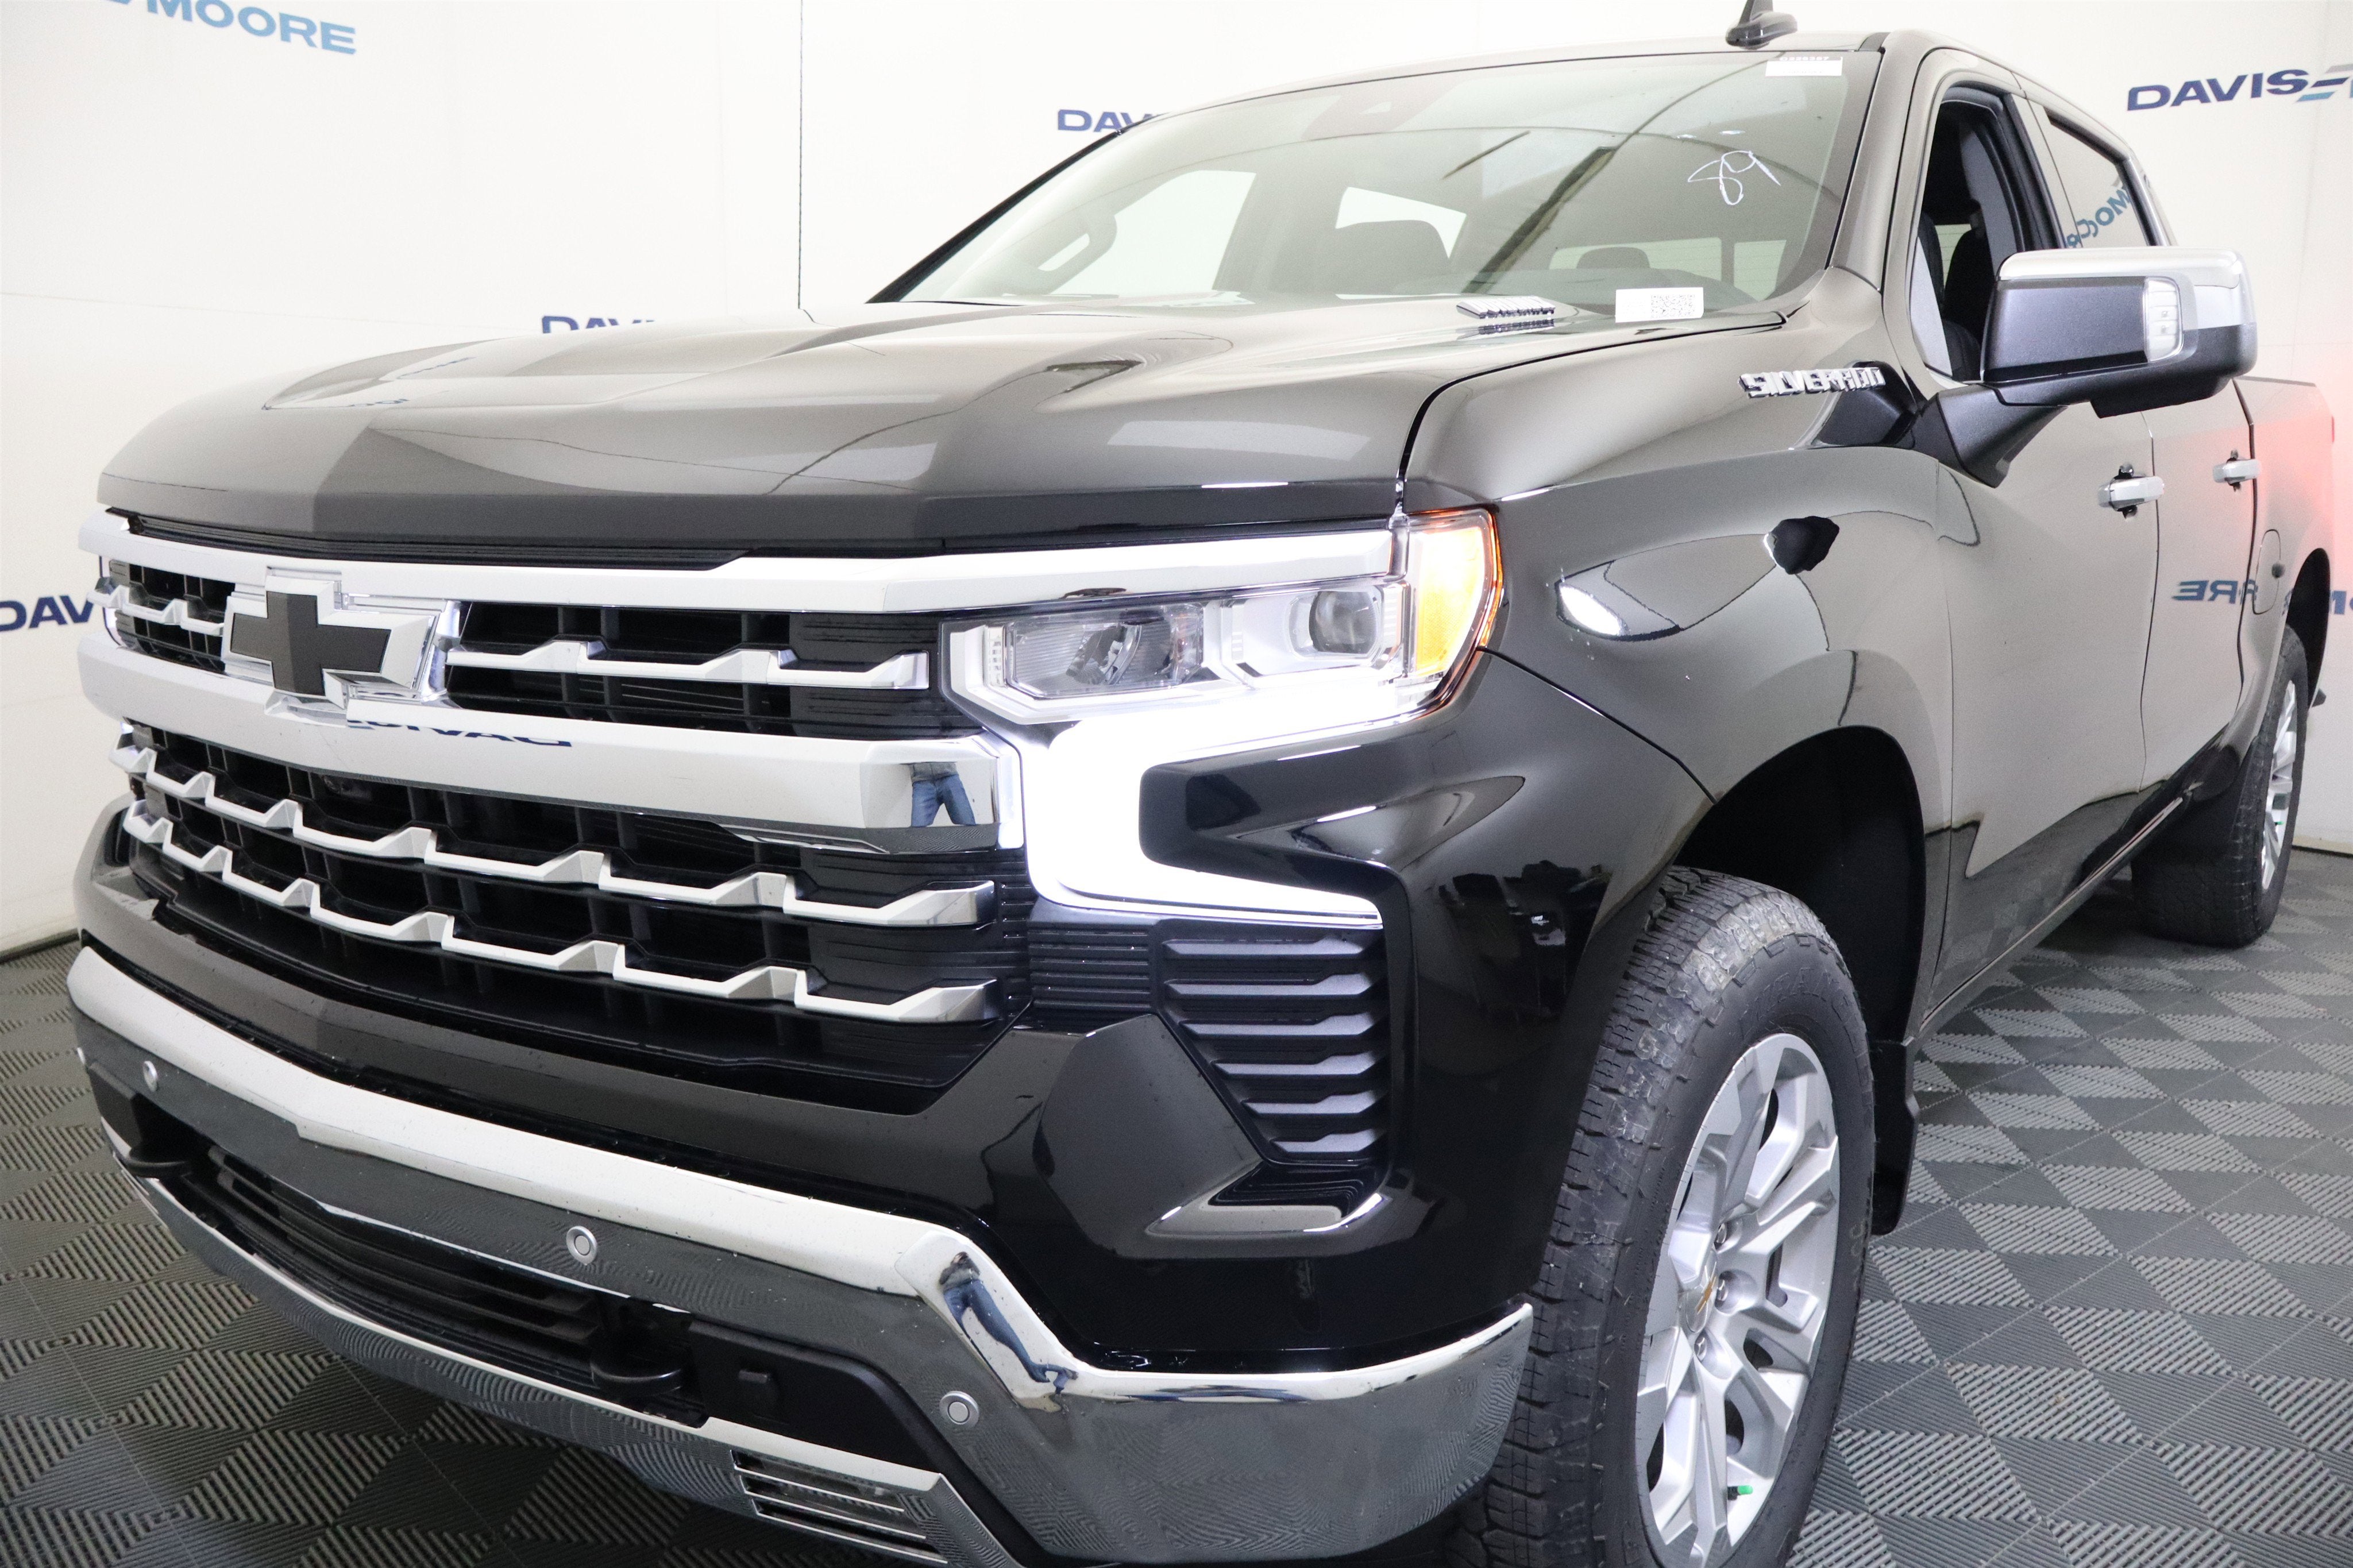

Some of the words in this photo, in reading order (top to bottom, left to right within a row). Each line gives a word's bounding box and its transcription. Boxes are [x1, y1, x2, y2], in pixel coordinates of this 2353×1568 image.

[147, 0, 356, 55] MOORE
[2127, 69, 2309, 111] DAVIS
[1738, 366, 1886, 398] SILVERADO
